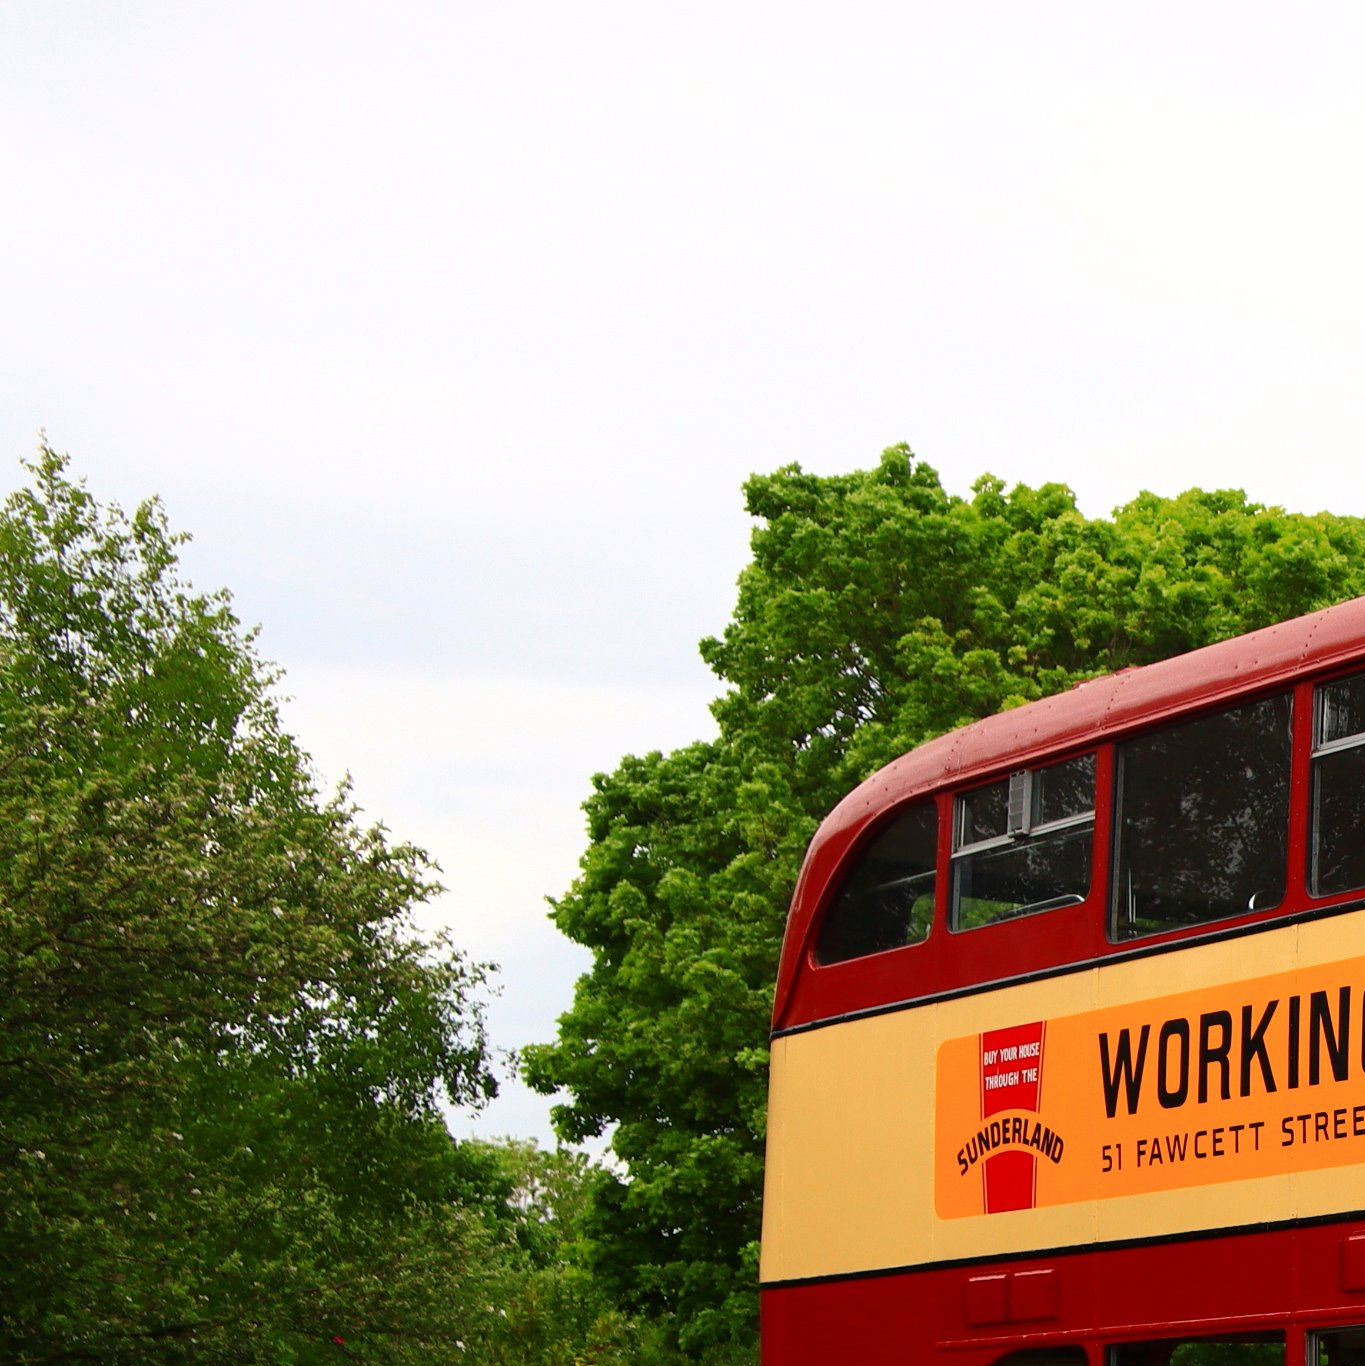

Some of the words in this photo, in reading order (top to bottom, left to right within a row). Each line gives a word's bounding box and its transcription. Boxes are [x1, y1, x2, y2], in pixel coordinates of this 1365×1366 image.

[984, 1050, 998, 1066] BUY
[1000, 1046, 1017, 1063] YOUR
[1018, 1042, 1040, 1059] HOUSE
[985, 1071, 1020, 1090] THROUGH
[1022, 1067, 1038, 1083] THE
[957, 1117, 1065, 1176] SUNDERLAND
[1101, 1143, 1122, 1173] 51
[1136, 1121, 1265, 1167] FAWCETT
